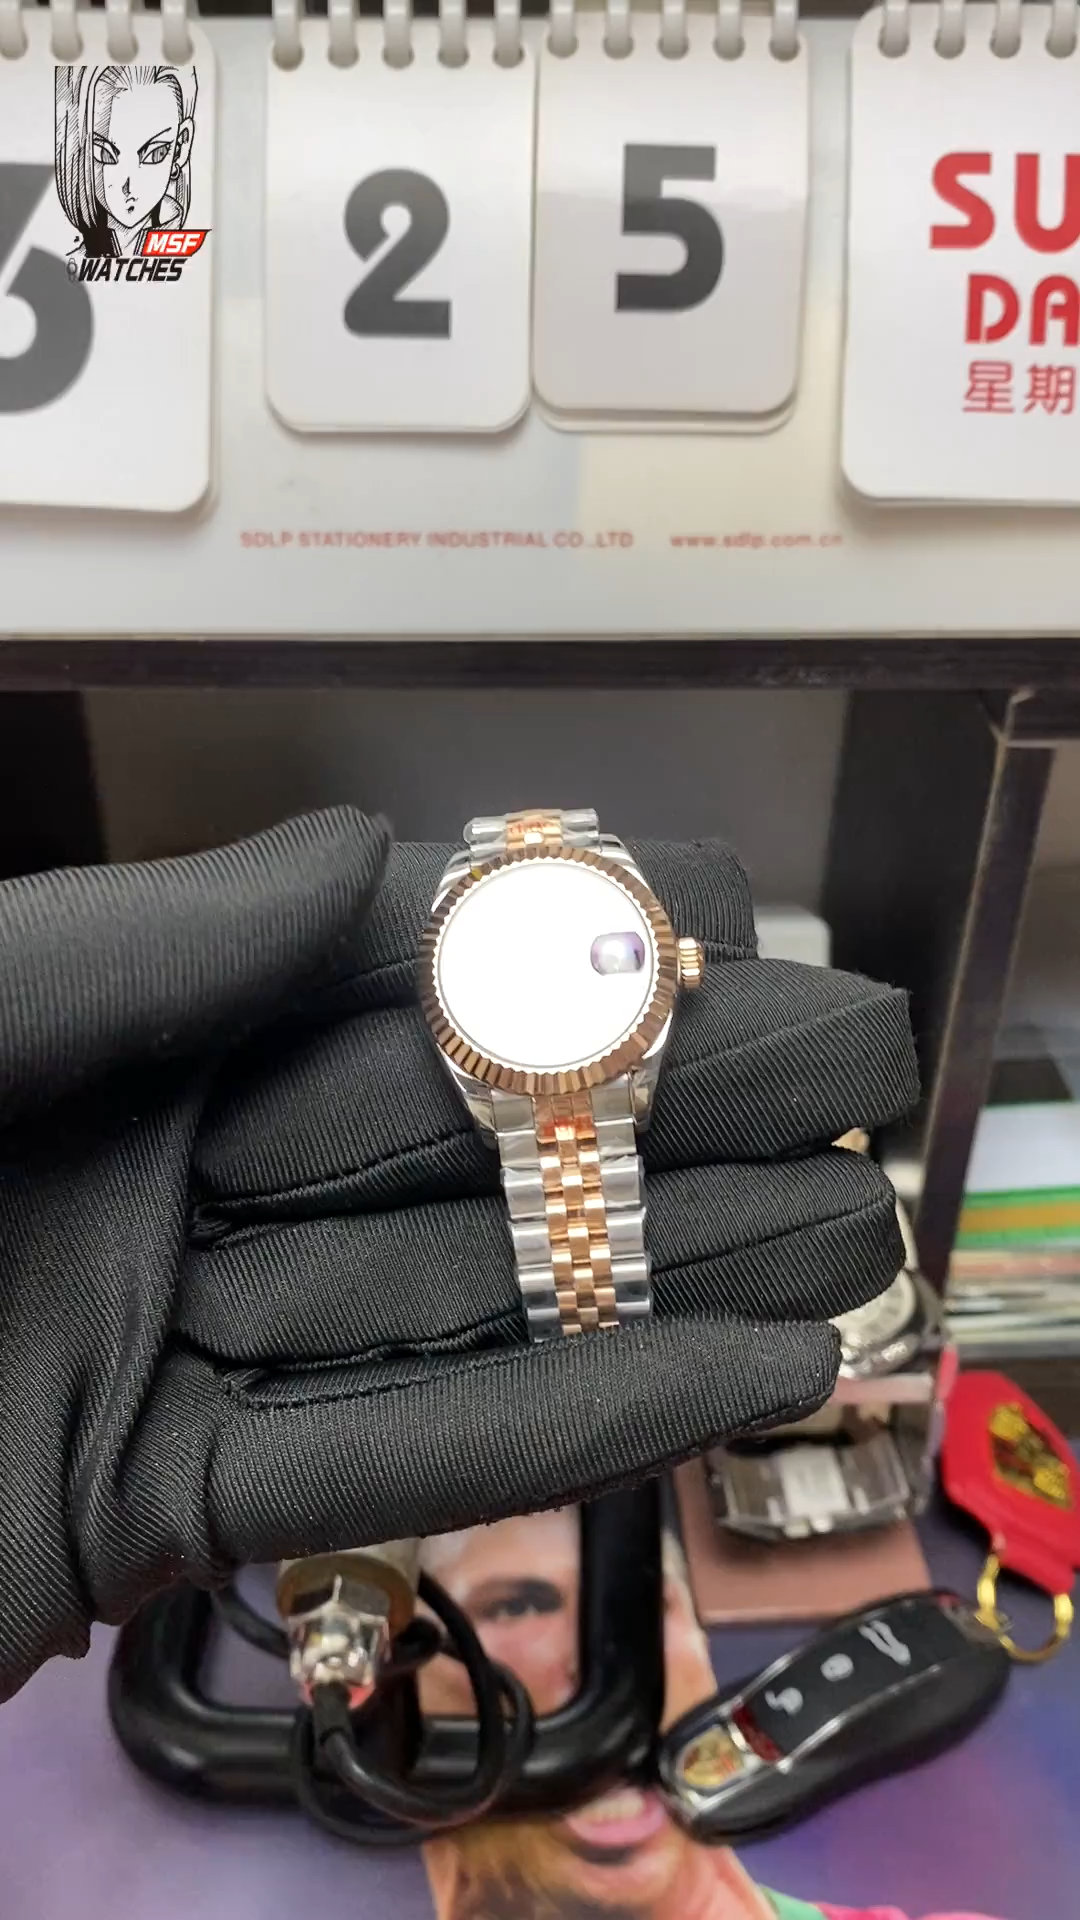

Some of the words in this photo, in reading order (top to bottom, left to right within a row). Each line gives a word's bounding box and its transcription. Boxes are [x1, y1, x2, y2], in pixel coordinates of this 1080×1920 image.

[343, 168, 452, 339] 2
[613, 143, 725, 315] 5
[964, 272, 1080, 346] DA
[962, 360, 1076, 415] 星期
[240, 530, 294, 548] SDLP
[299, 530, 422, 548] STATIONERY
[428, 530, 547, 548] INDUSTRIAL
